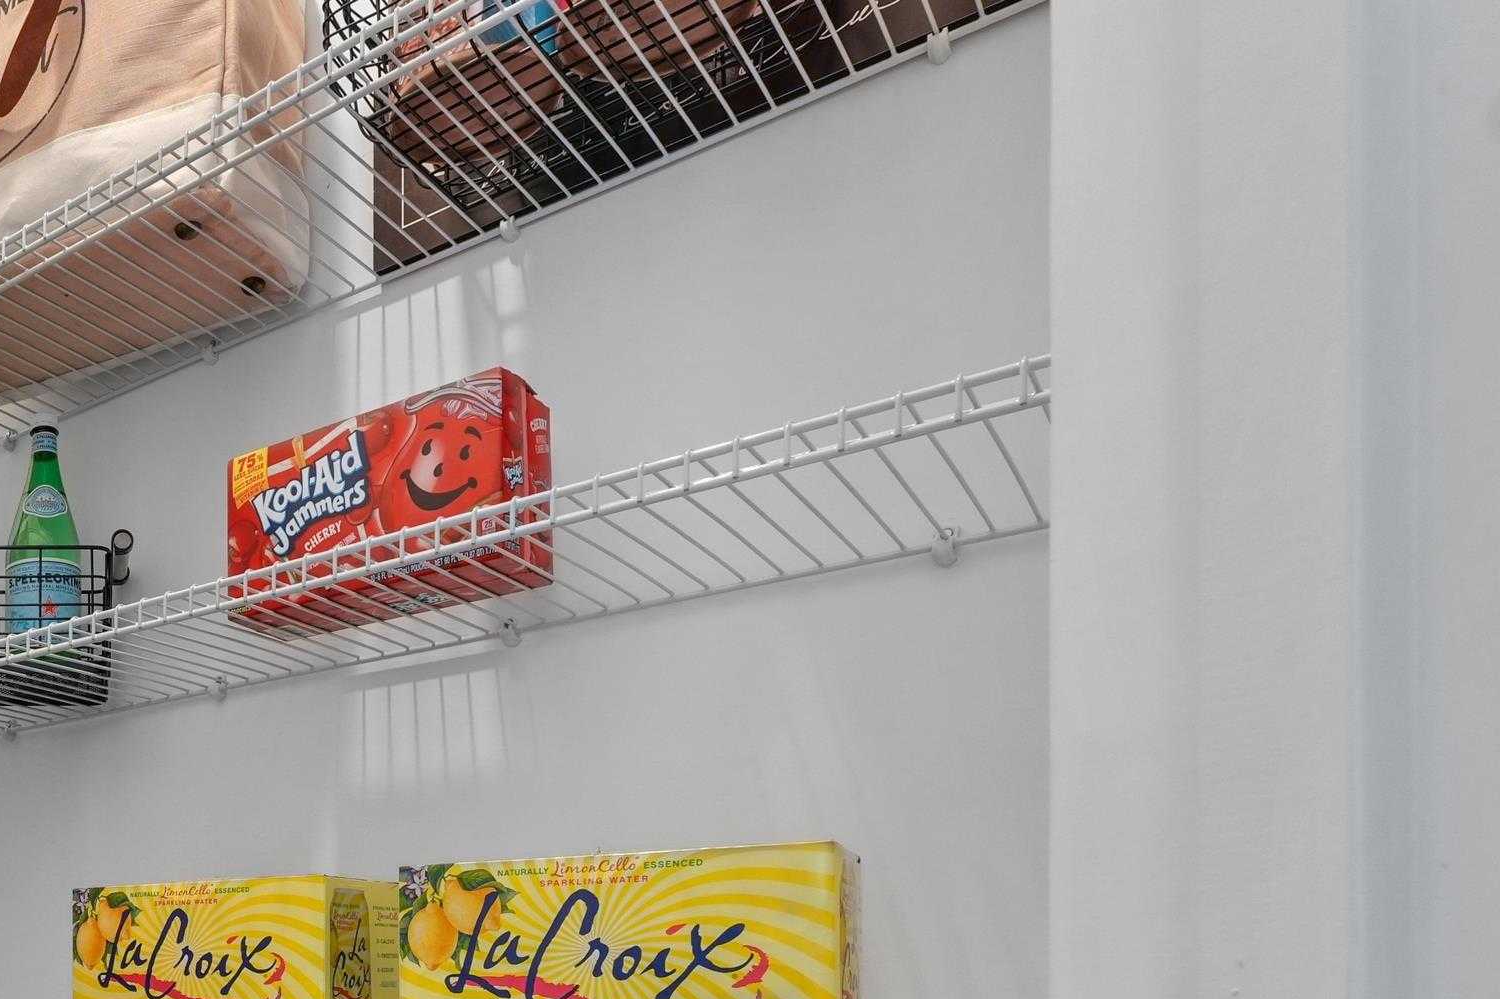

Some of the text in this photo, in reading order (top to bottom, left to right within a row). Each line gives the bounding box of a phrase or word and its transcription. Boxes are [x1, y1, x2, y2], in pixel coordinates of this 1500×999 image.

[252, 431, 364, 532] Kool-Aid
[273, 479, 367, 556] Jammers
[304, 520, 342, 552] CHERRY
[497, 866, 549, 877] NATURALLY
[643, 858, 704, 870] ESSENCED
[214, 886, 250, 894] ESSENCED
[540, 875, 649, 888] SPARKLING WATER
